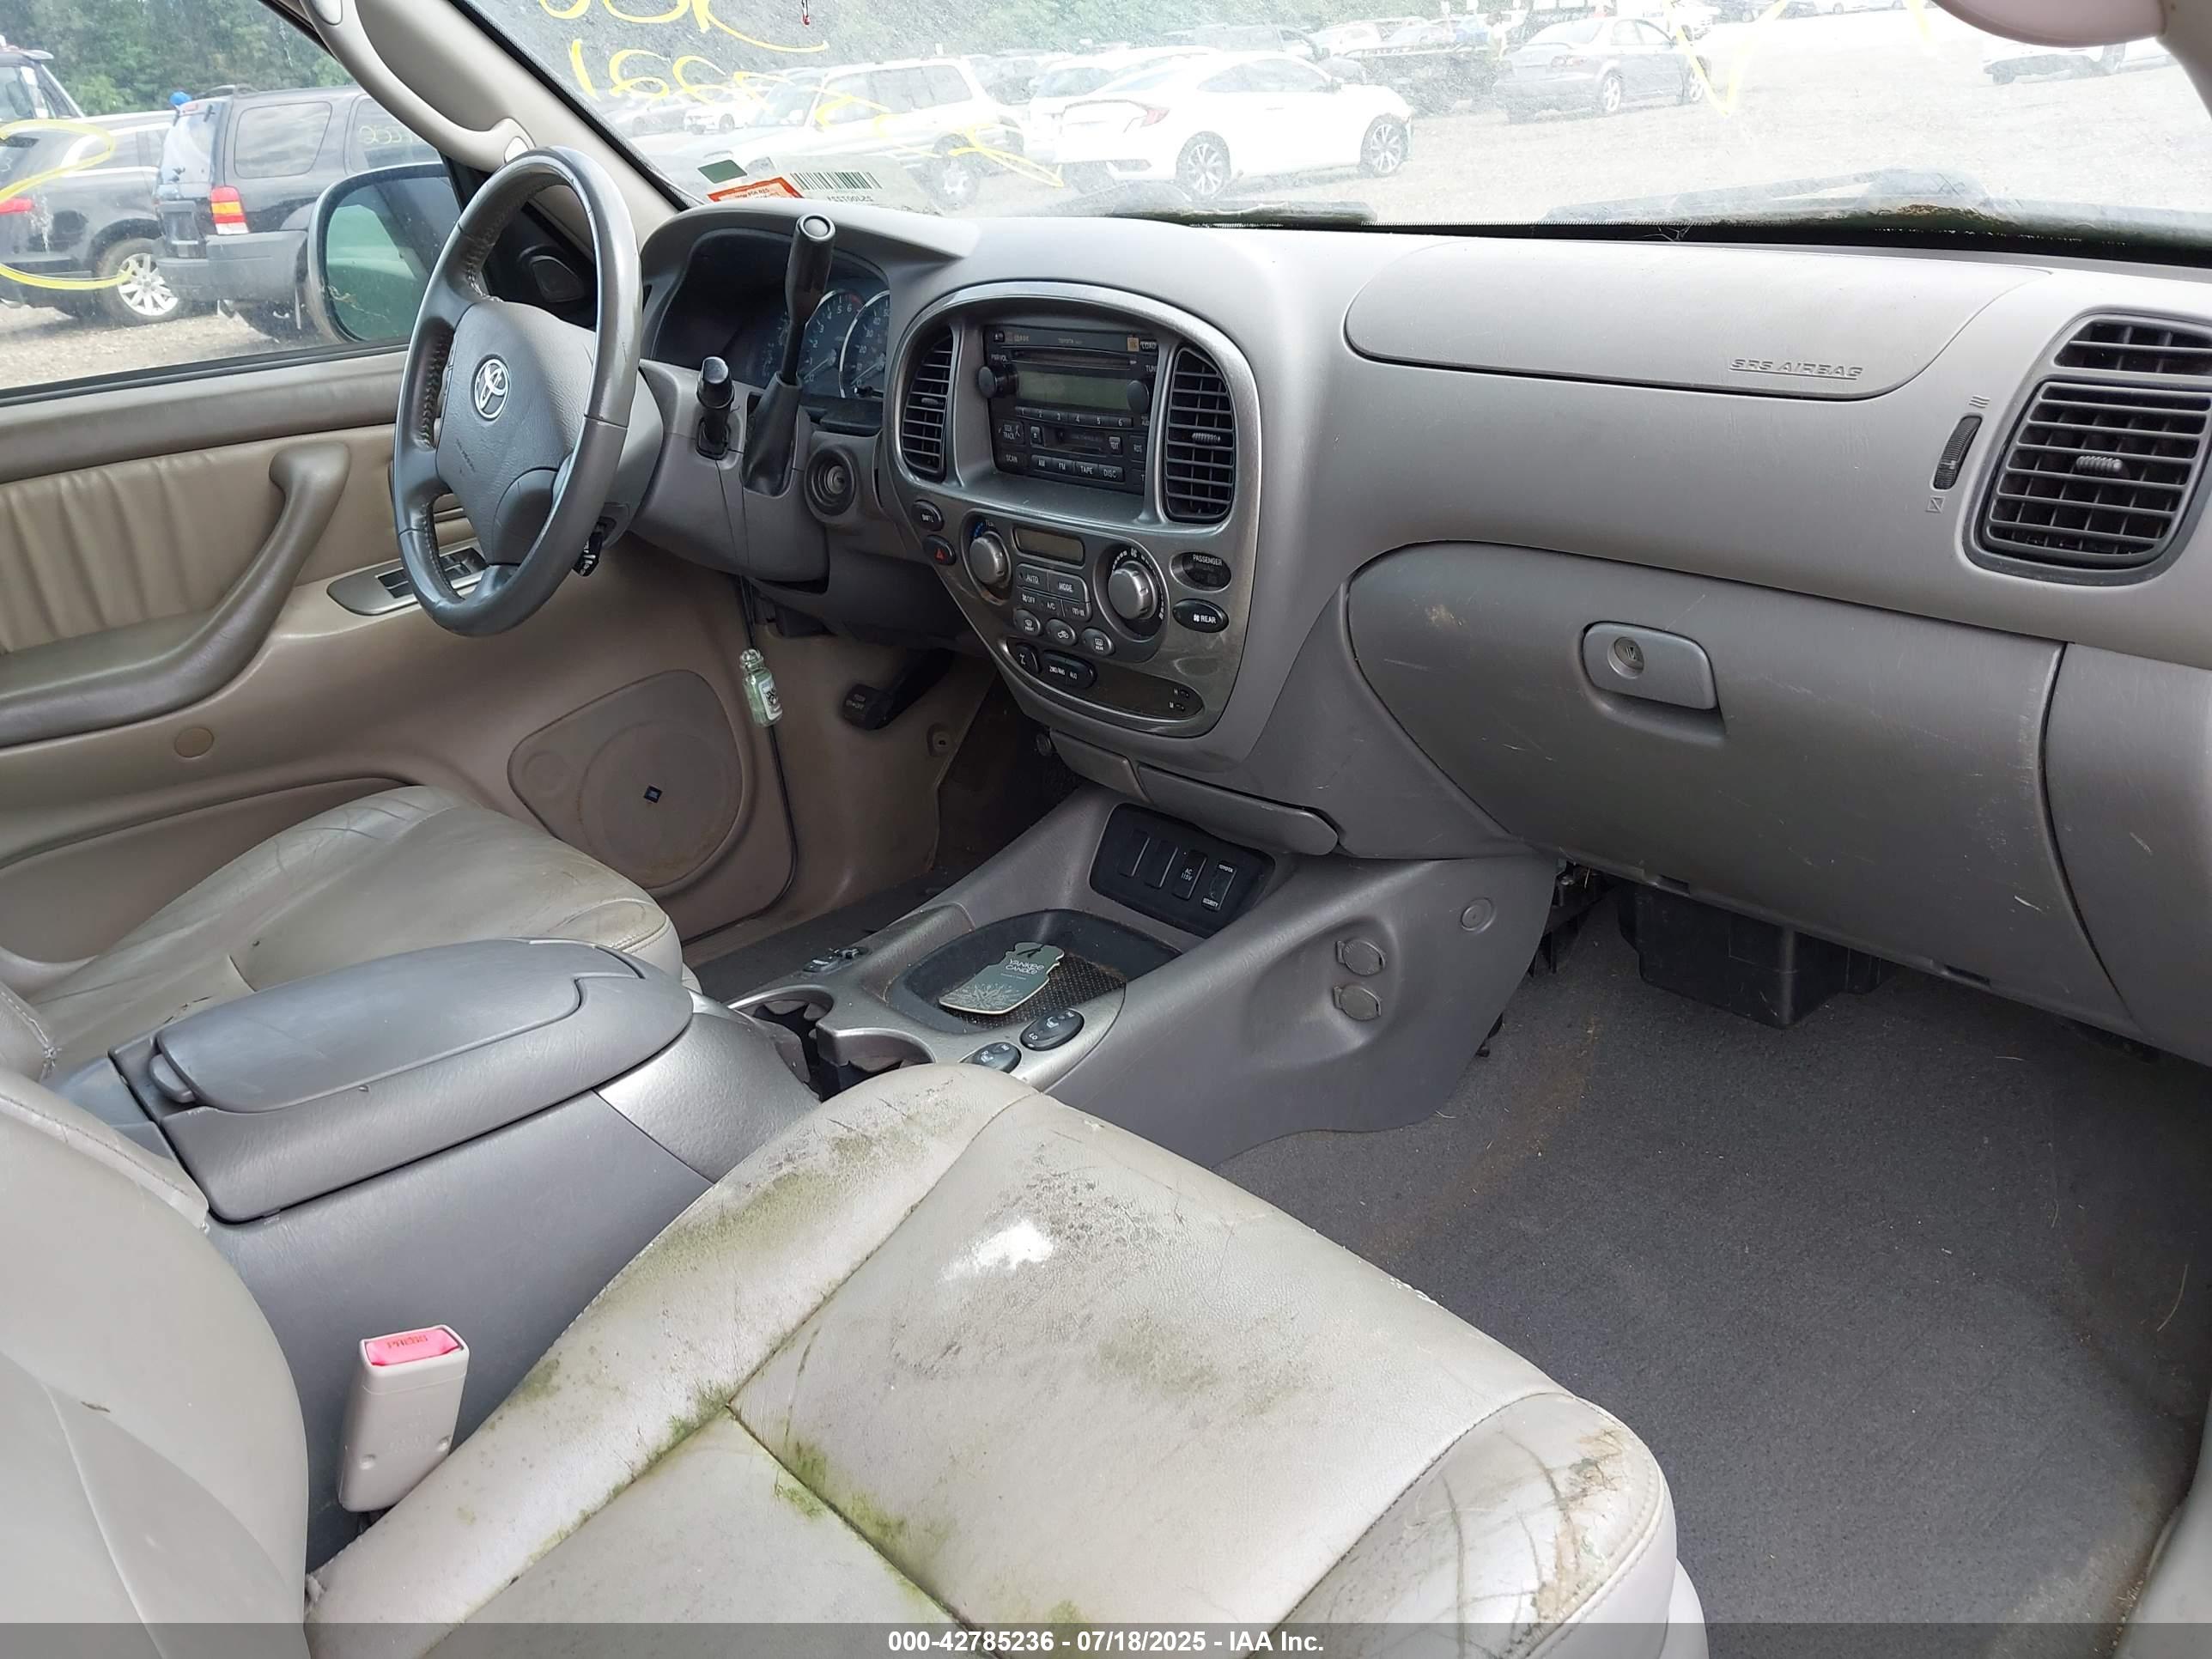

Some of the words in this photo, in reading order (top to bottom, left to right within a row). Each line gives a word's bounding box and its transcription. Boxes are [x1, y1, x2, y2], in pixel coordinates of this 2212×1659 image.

[1730, 358, 1773, 371] SRS
[1778, 362, 1863, 377] AIRBAG
[1006, 454, 1018, 463] SCAN
[1038, 459, 1045, 468] AM
[1058, 462, 1066, 471] FM
[1080, 465, 1093, 475] TAPE
[1103, 468, 1116, 478] DISC
[1193, 554, 1223, 567] PASSENGER
[1025, 574, 1039, 585] AUTO
[1059, 582, 1073, 592] MODE
[1200, 615, 1217, 624] REAR
